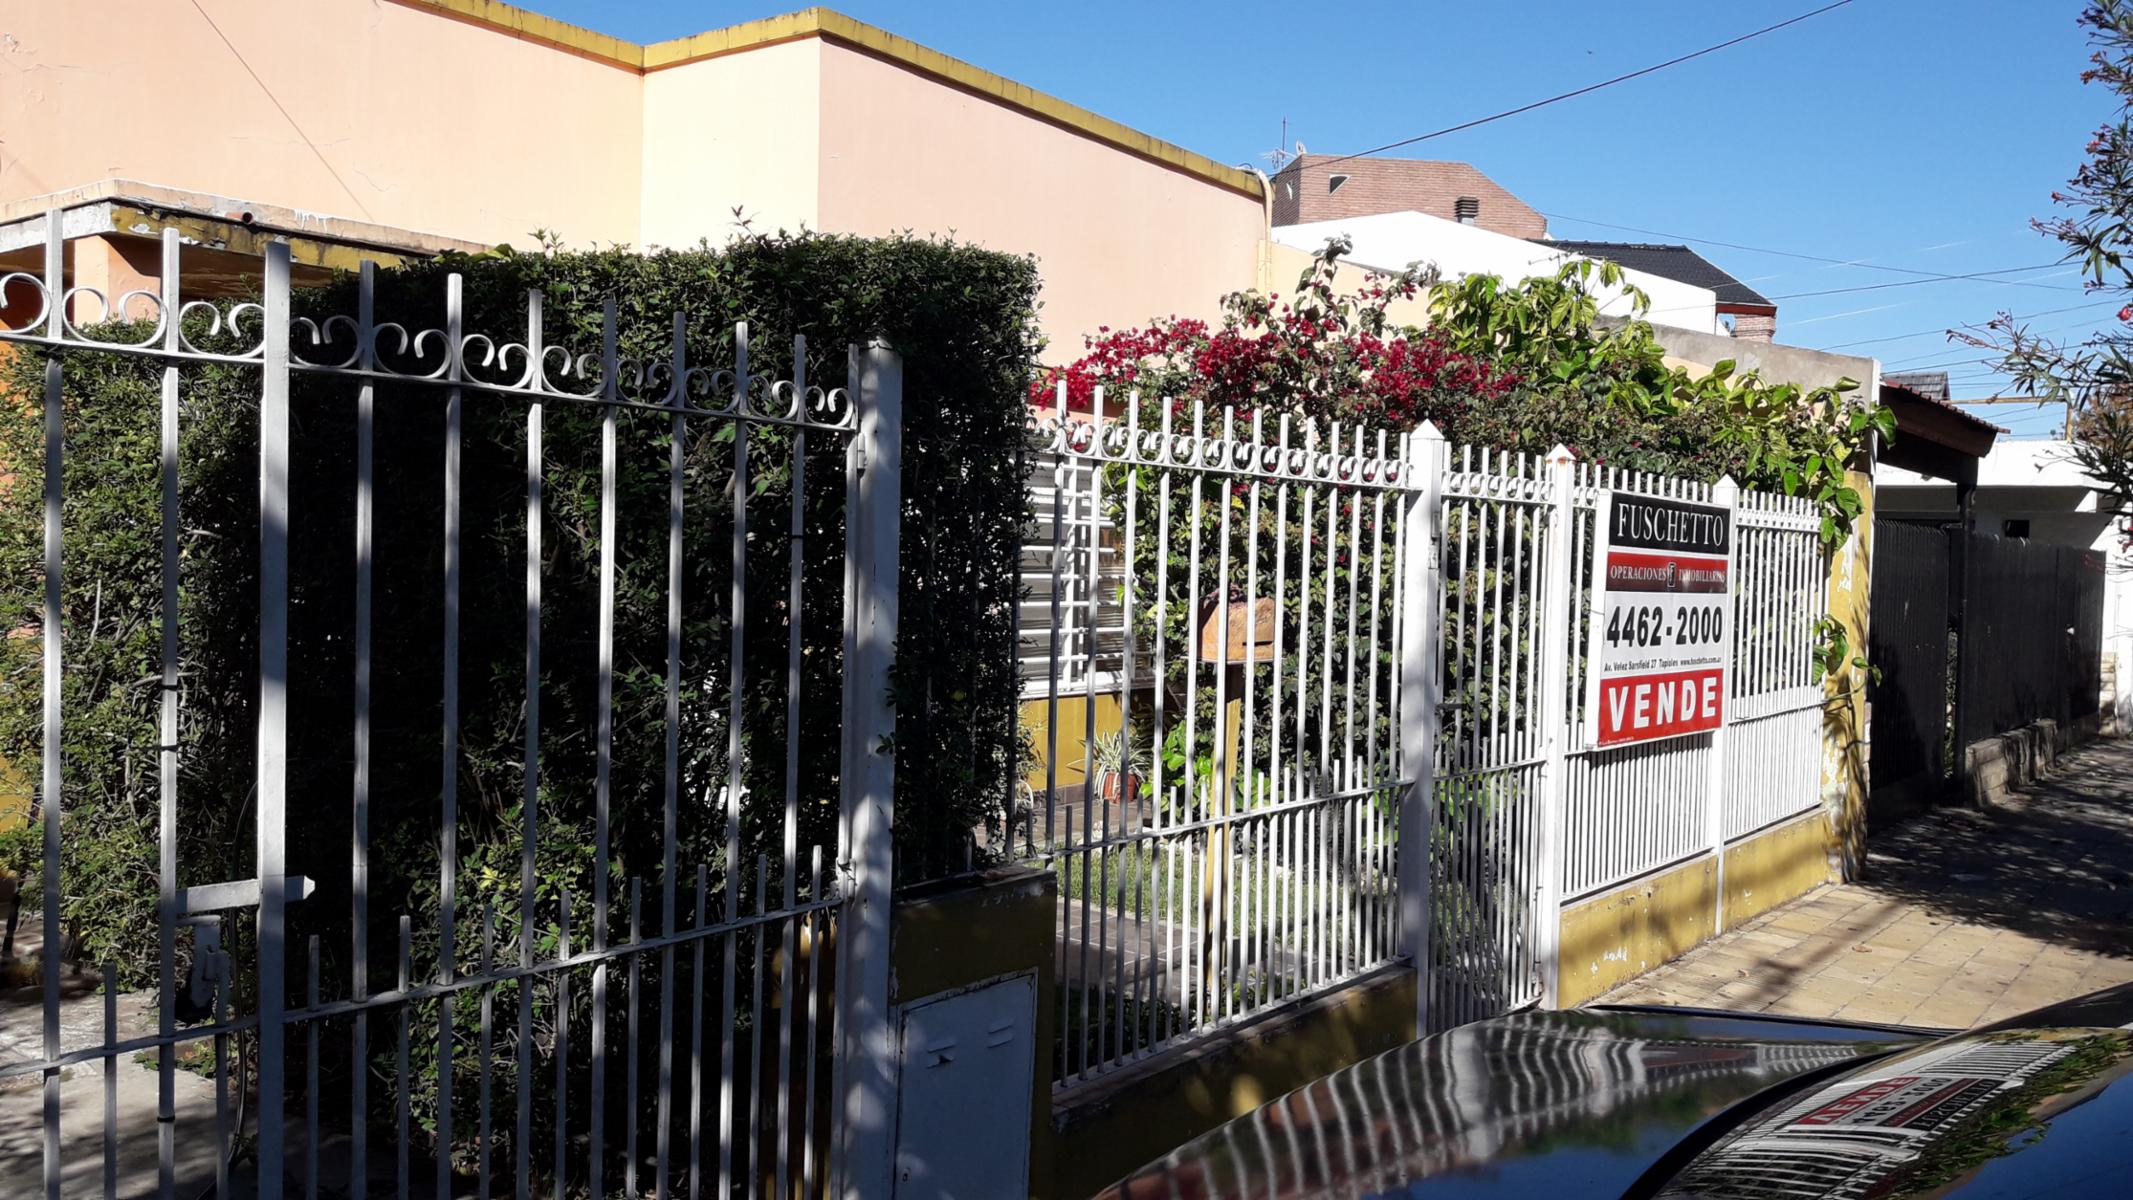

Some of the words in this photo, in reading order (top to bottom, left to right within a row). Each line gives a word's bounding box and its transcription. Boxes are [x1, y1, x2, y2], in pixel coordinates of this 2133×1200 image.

[1617, 503, 1724, 546] FUSCHETTO
[1610, 565, 1667, 581] OPERACIONES
[1606, 606, 1723, 648] 4462-2000
[1604, 663, 1613, 672] Av.
[1628, 660, 1650, 670] Sarsfield
[1608, 677, 1718, 732] VENDE
